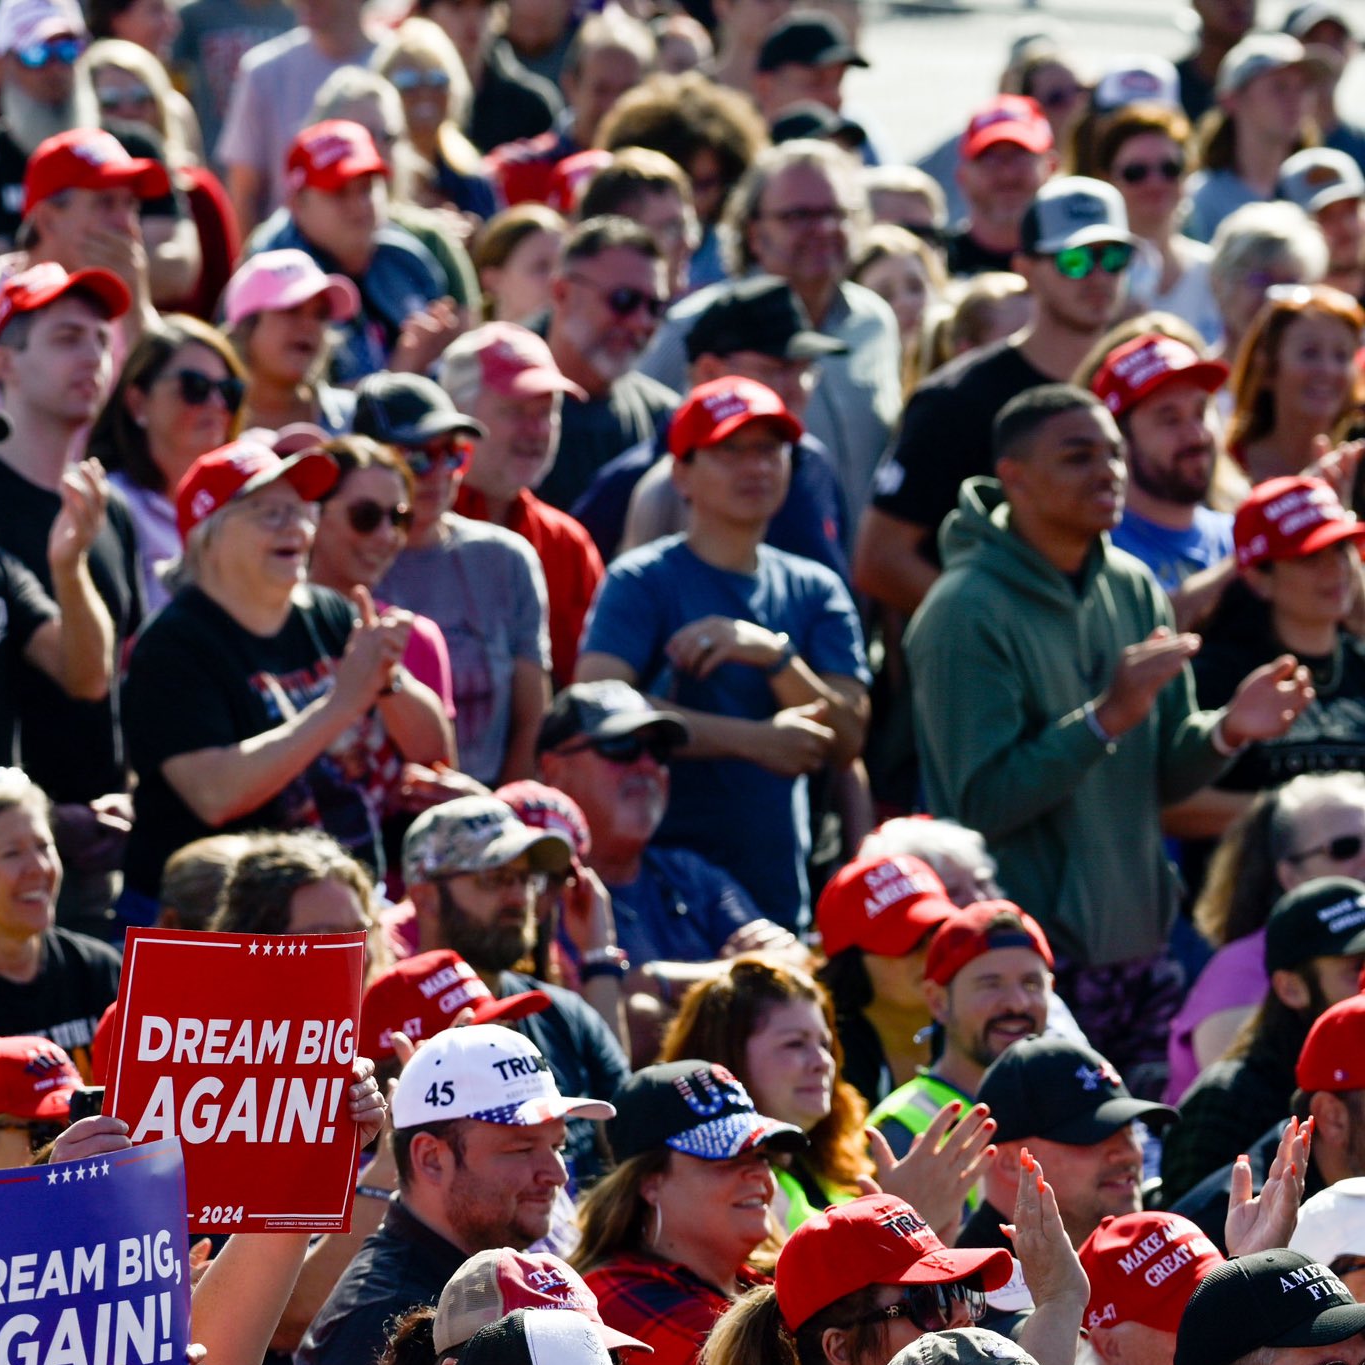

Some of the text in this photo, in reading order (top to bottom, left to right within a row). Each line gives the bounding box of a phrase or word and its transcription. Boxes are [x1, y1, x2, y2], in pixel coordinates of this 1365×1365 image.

[137, 1015, 287, 1065] DREAM
[492, 1051, 553, 1087] TRU
[130, 1075, 345, 1144] AGAIN!
[424, 1080, 455, 1107] 45
[199, 1205, 244, 1225] 2024
[880, 1211, 928, 1238] TRU
[115, 1229, 182, 1286] BIG,
[1117, 1229, 1166, 1276] MAKE
[1144, 1241, 1197, 1288] GREAT
